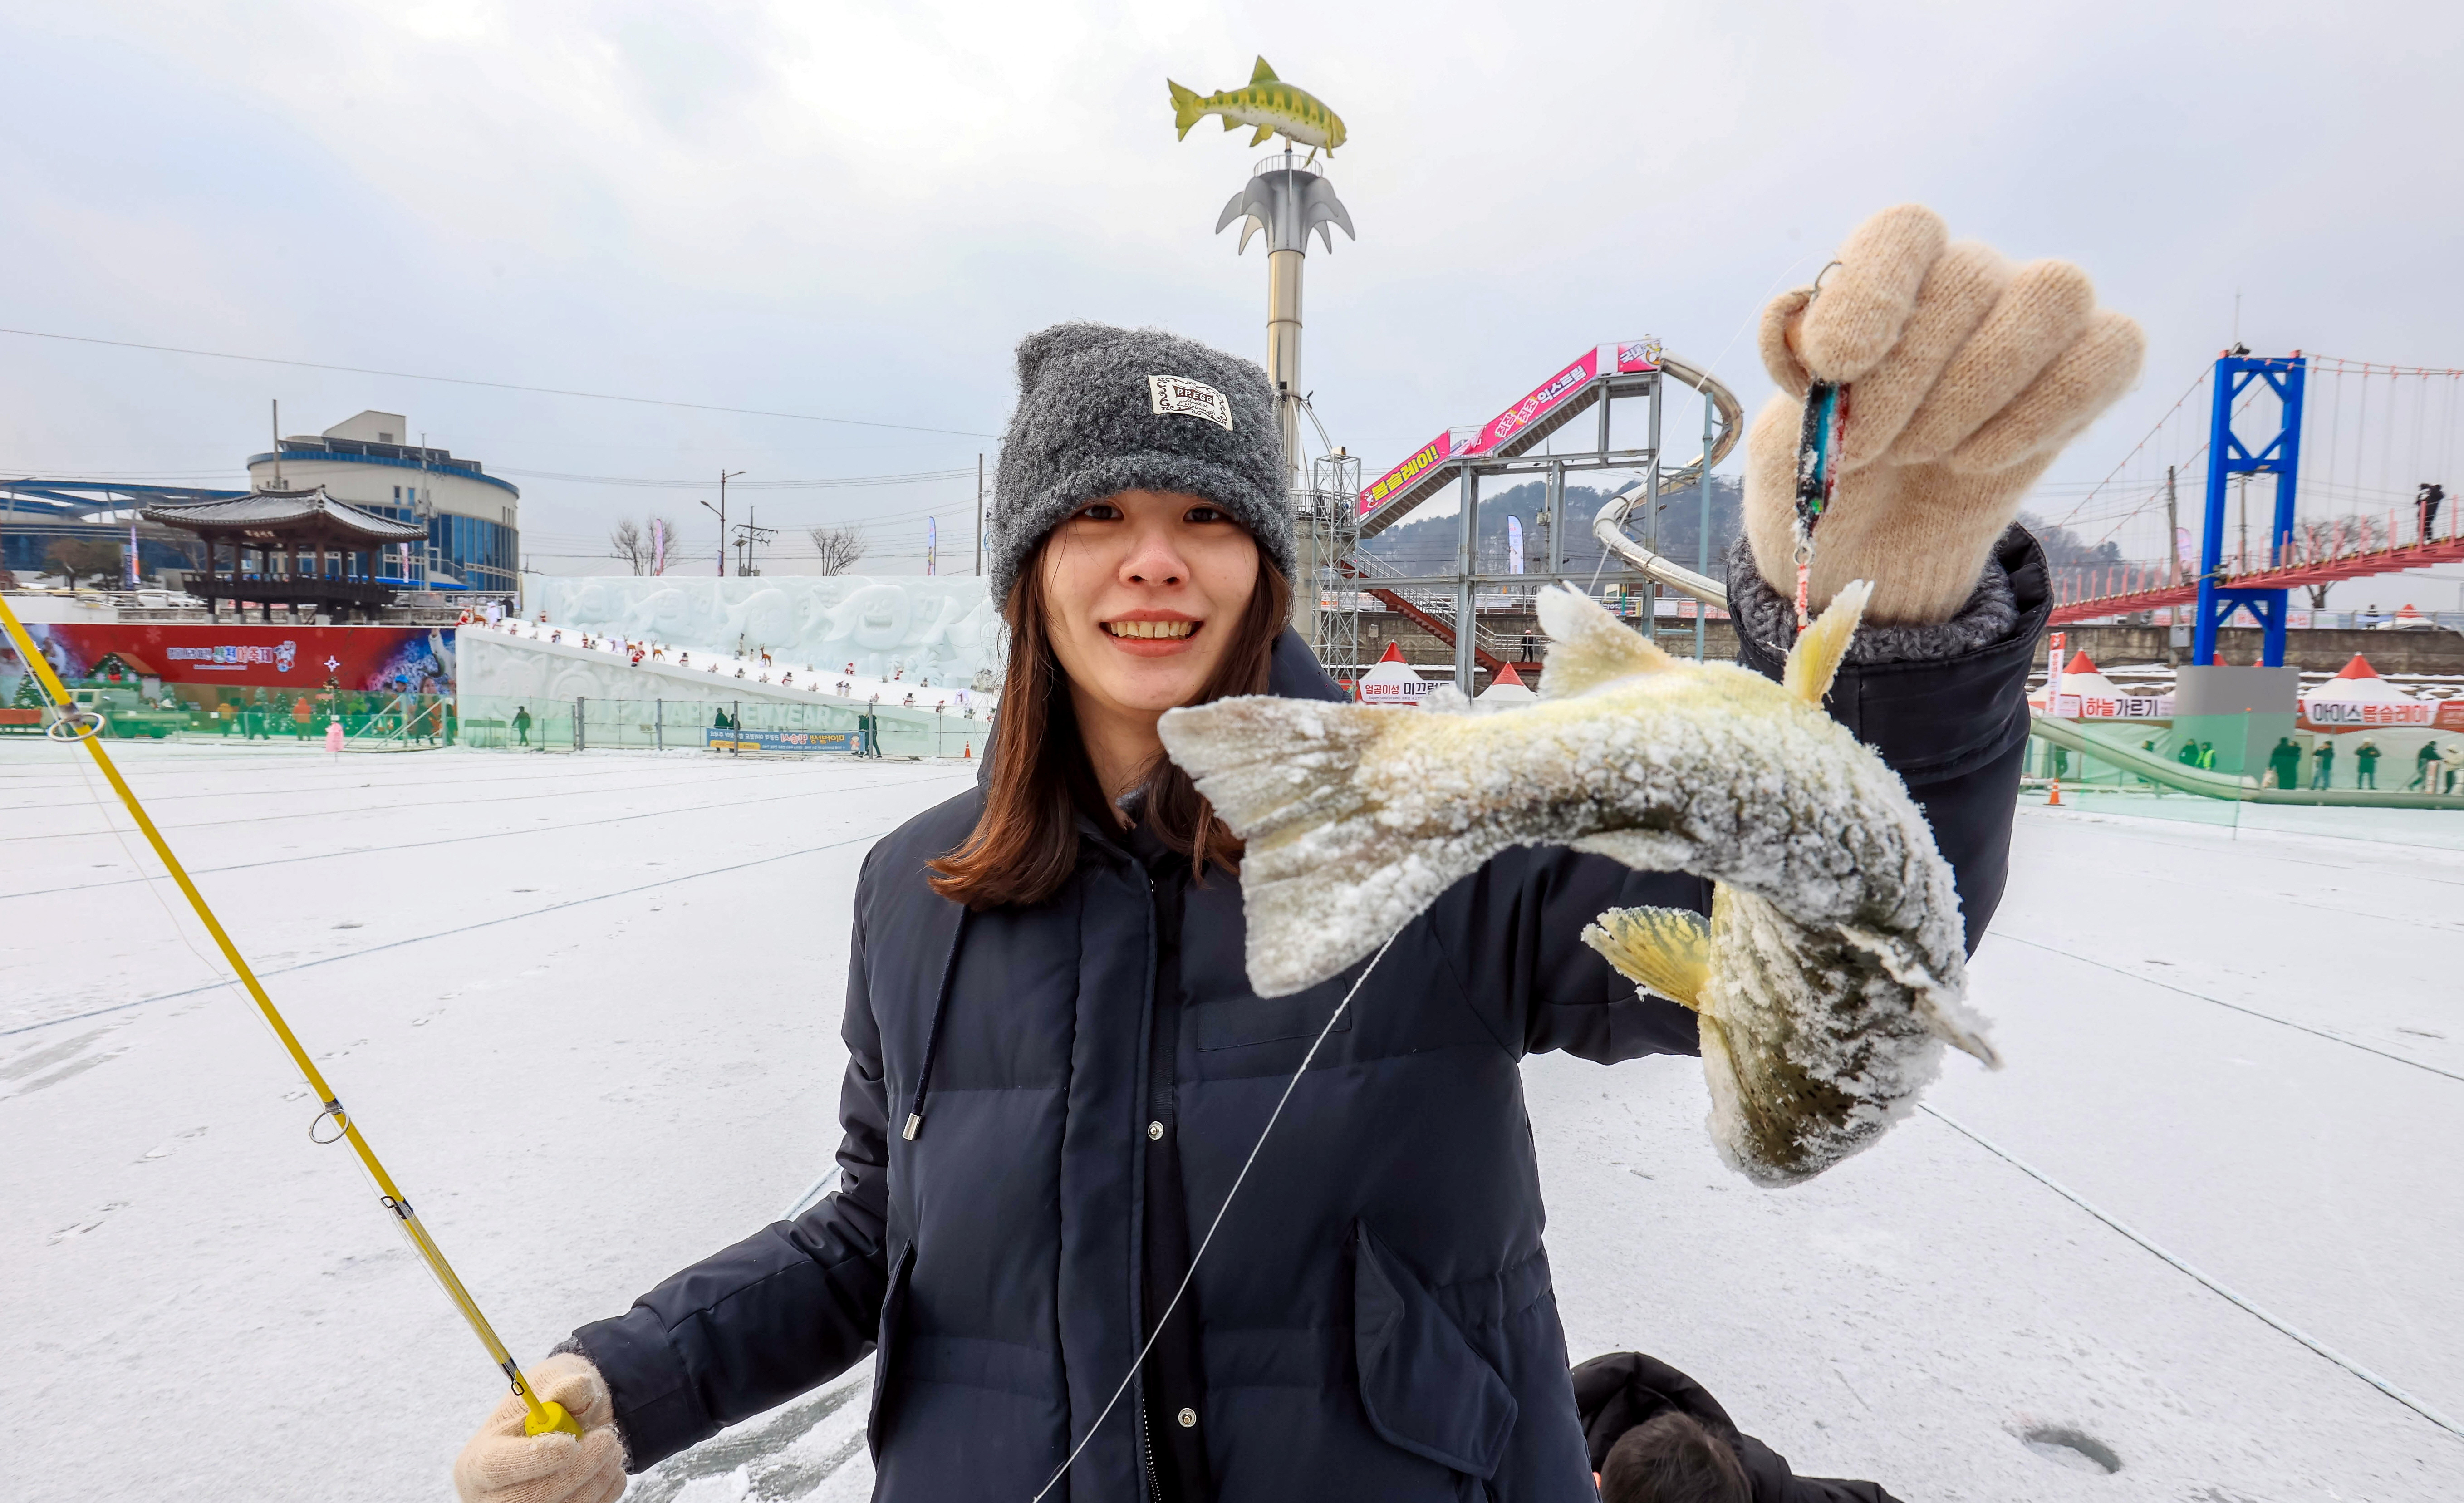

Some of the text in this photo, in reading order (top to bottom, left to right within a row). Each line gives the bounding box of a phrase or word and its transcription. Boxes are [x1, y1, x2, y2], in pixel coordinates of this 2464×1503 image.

[1495, 364, 1587, 437] 최장 최초 익스트림
[1371, 444, 1439, 501] 봅슬레이!
[1365, 683, 1449, 695] 얼곰이성 미끄럼
[2086, 698, 2158, 716] 하늘가르기
